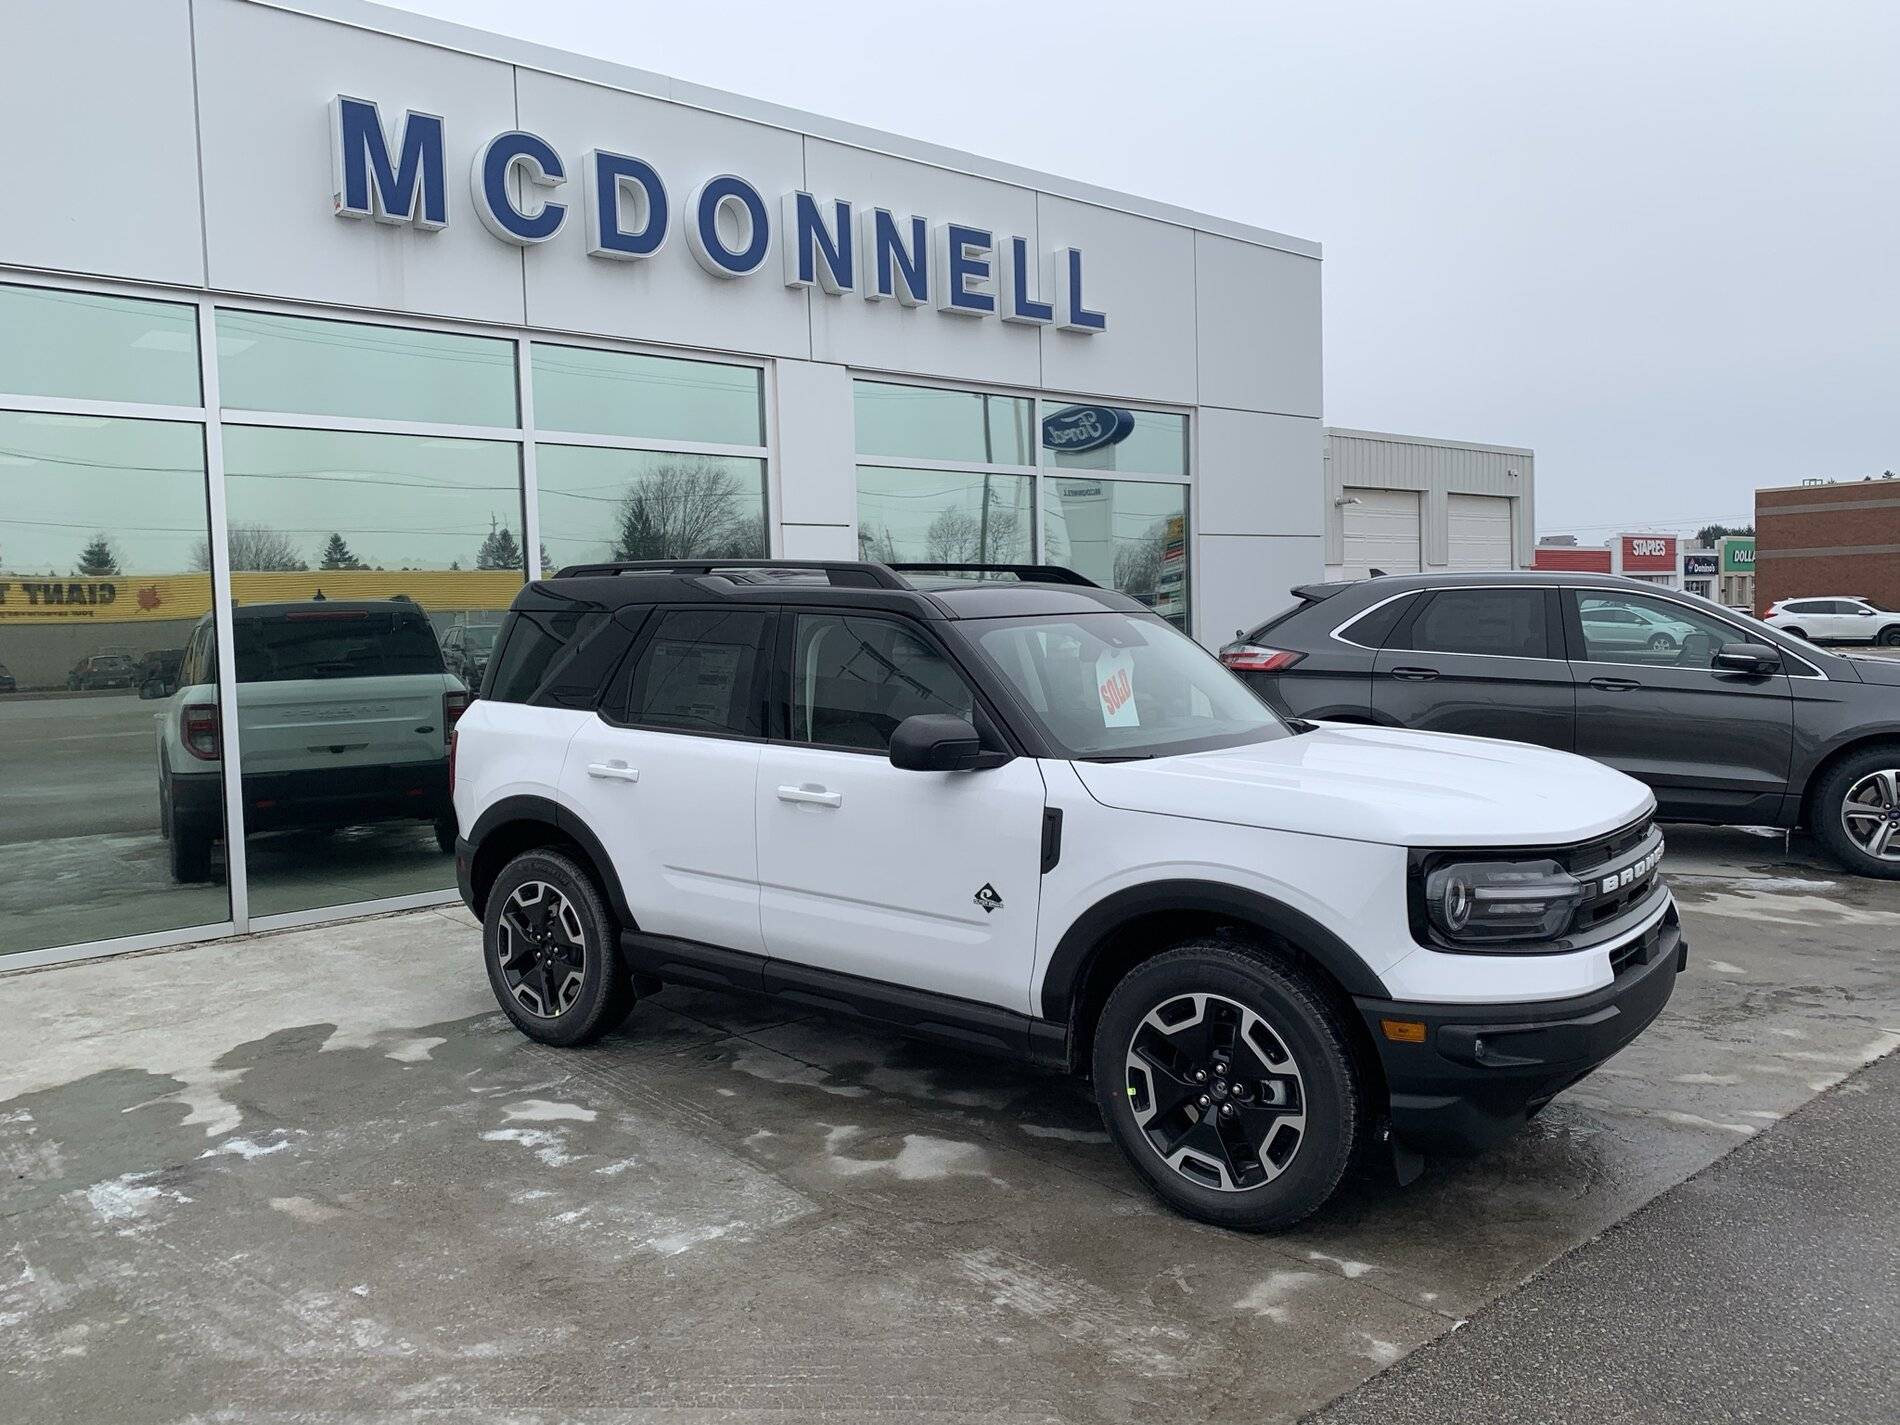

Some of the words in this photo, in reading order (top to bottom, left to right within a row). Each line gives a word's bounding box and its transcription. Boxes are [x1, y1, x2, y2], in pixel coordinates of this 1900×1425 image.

[330, 94, 1106, 333] MCDONNELL
[1632, 540, 1666, 556] STAPLES
[1694, 563, 1716, 573] Domino's
[1100, 668, 1131, 716] SOLD
